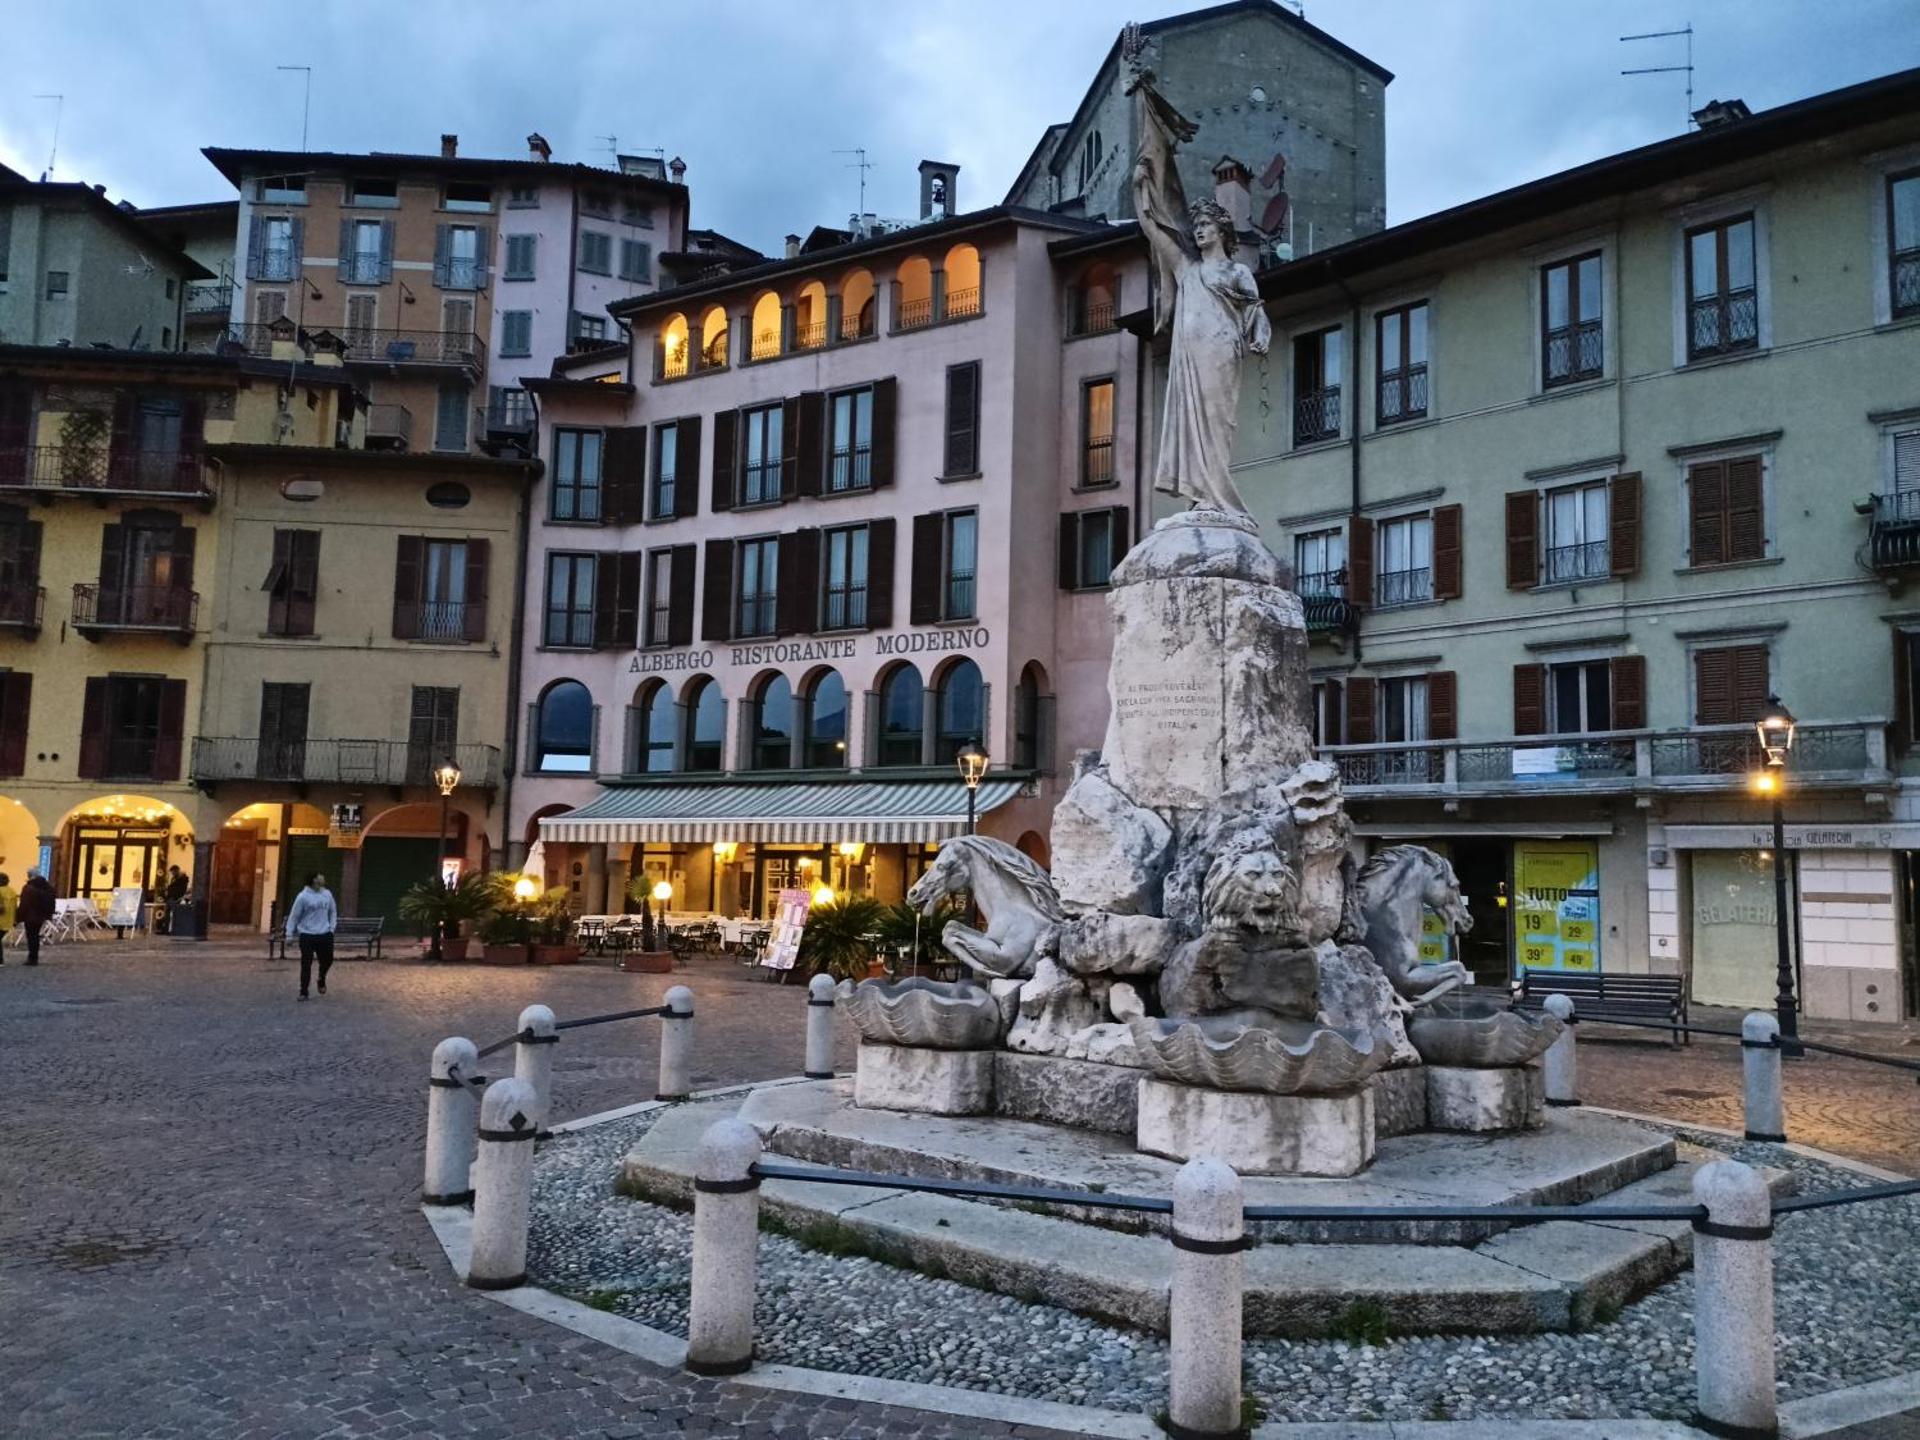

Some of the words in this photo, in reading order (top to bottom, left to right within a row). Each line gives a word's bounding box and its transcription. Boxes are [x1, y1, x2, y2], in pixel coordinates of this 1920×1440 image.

[629, 650, 714, 673] ALBERGO
[731, 639, 856, 666] RISTORANTE
[875, 627, 990, 656] MODERNO
[1527, 887, 1568, 902] TUTTO
